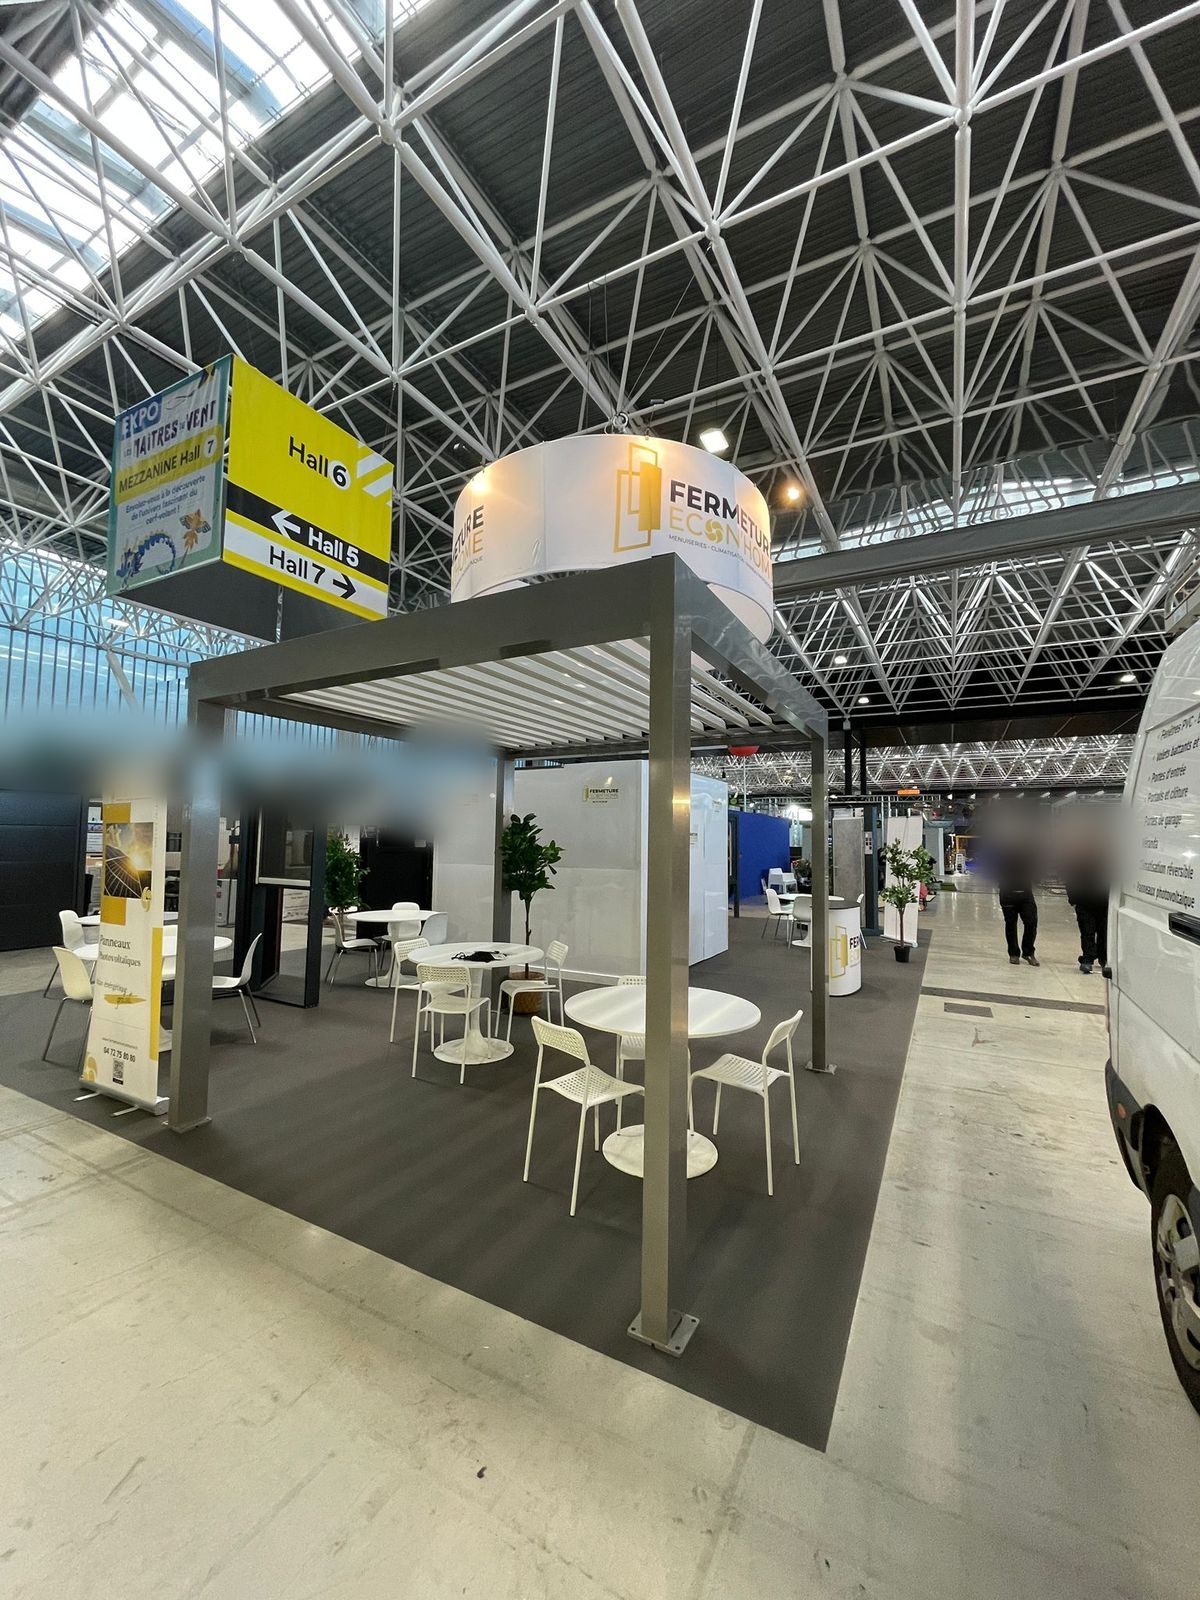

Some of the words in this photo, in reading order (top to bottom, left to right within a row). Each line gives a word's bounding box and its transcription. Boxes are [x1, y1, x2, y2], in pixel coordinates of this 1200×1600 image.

[121, 401, 159, 438] EXPO
[186, 400, 216, 431] VENT
[119, 456, 177, 493] MEZZANINE
[180, 445, 200, 466] Hall
[207, 440, 214, 454] 7
[288, 435, 328, 478] Hall
[332, 464, 347, 487] 6
[670, 479, 771, 560] FERMETUR
[269, 545, 307, 579] Hall
[312, 563, 326, 584] 7
[308, 527, 343, 561] Hall
[346, 546, 359, 567] 5
